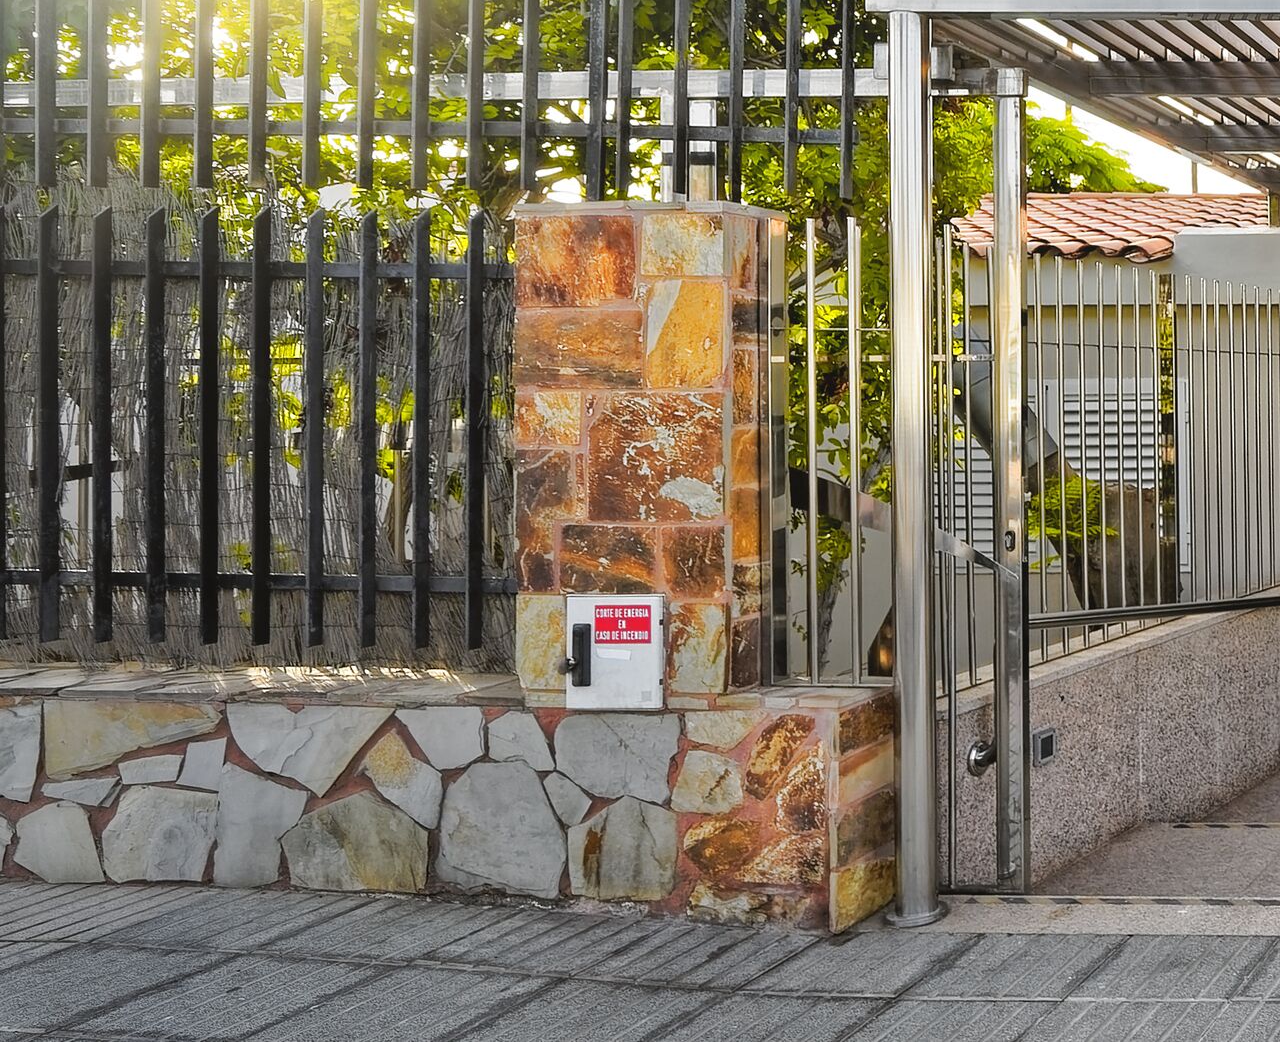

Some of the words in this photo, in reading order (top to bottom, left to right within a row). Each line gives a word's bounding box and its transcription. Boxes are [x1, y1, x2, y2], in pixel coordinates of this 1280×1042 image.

[596, 608, 614, 618] CORTE
[614, 608, 623, 618] DE
[618, 619, 626, 629] EN
[596, 630, 610, 640] CASO
[611, 630, 620, 640] DE
[620, 630, 649, 640] INCENDIO
